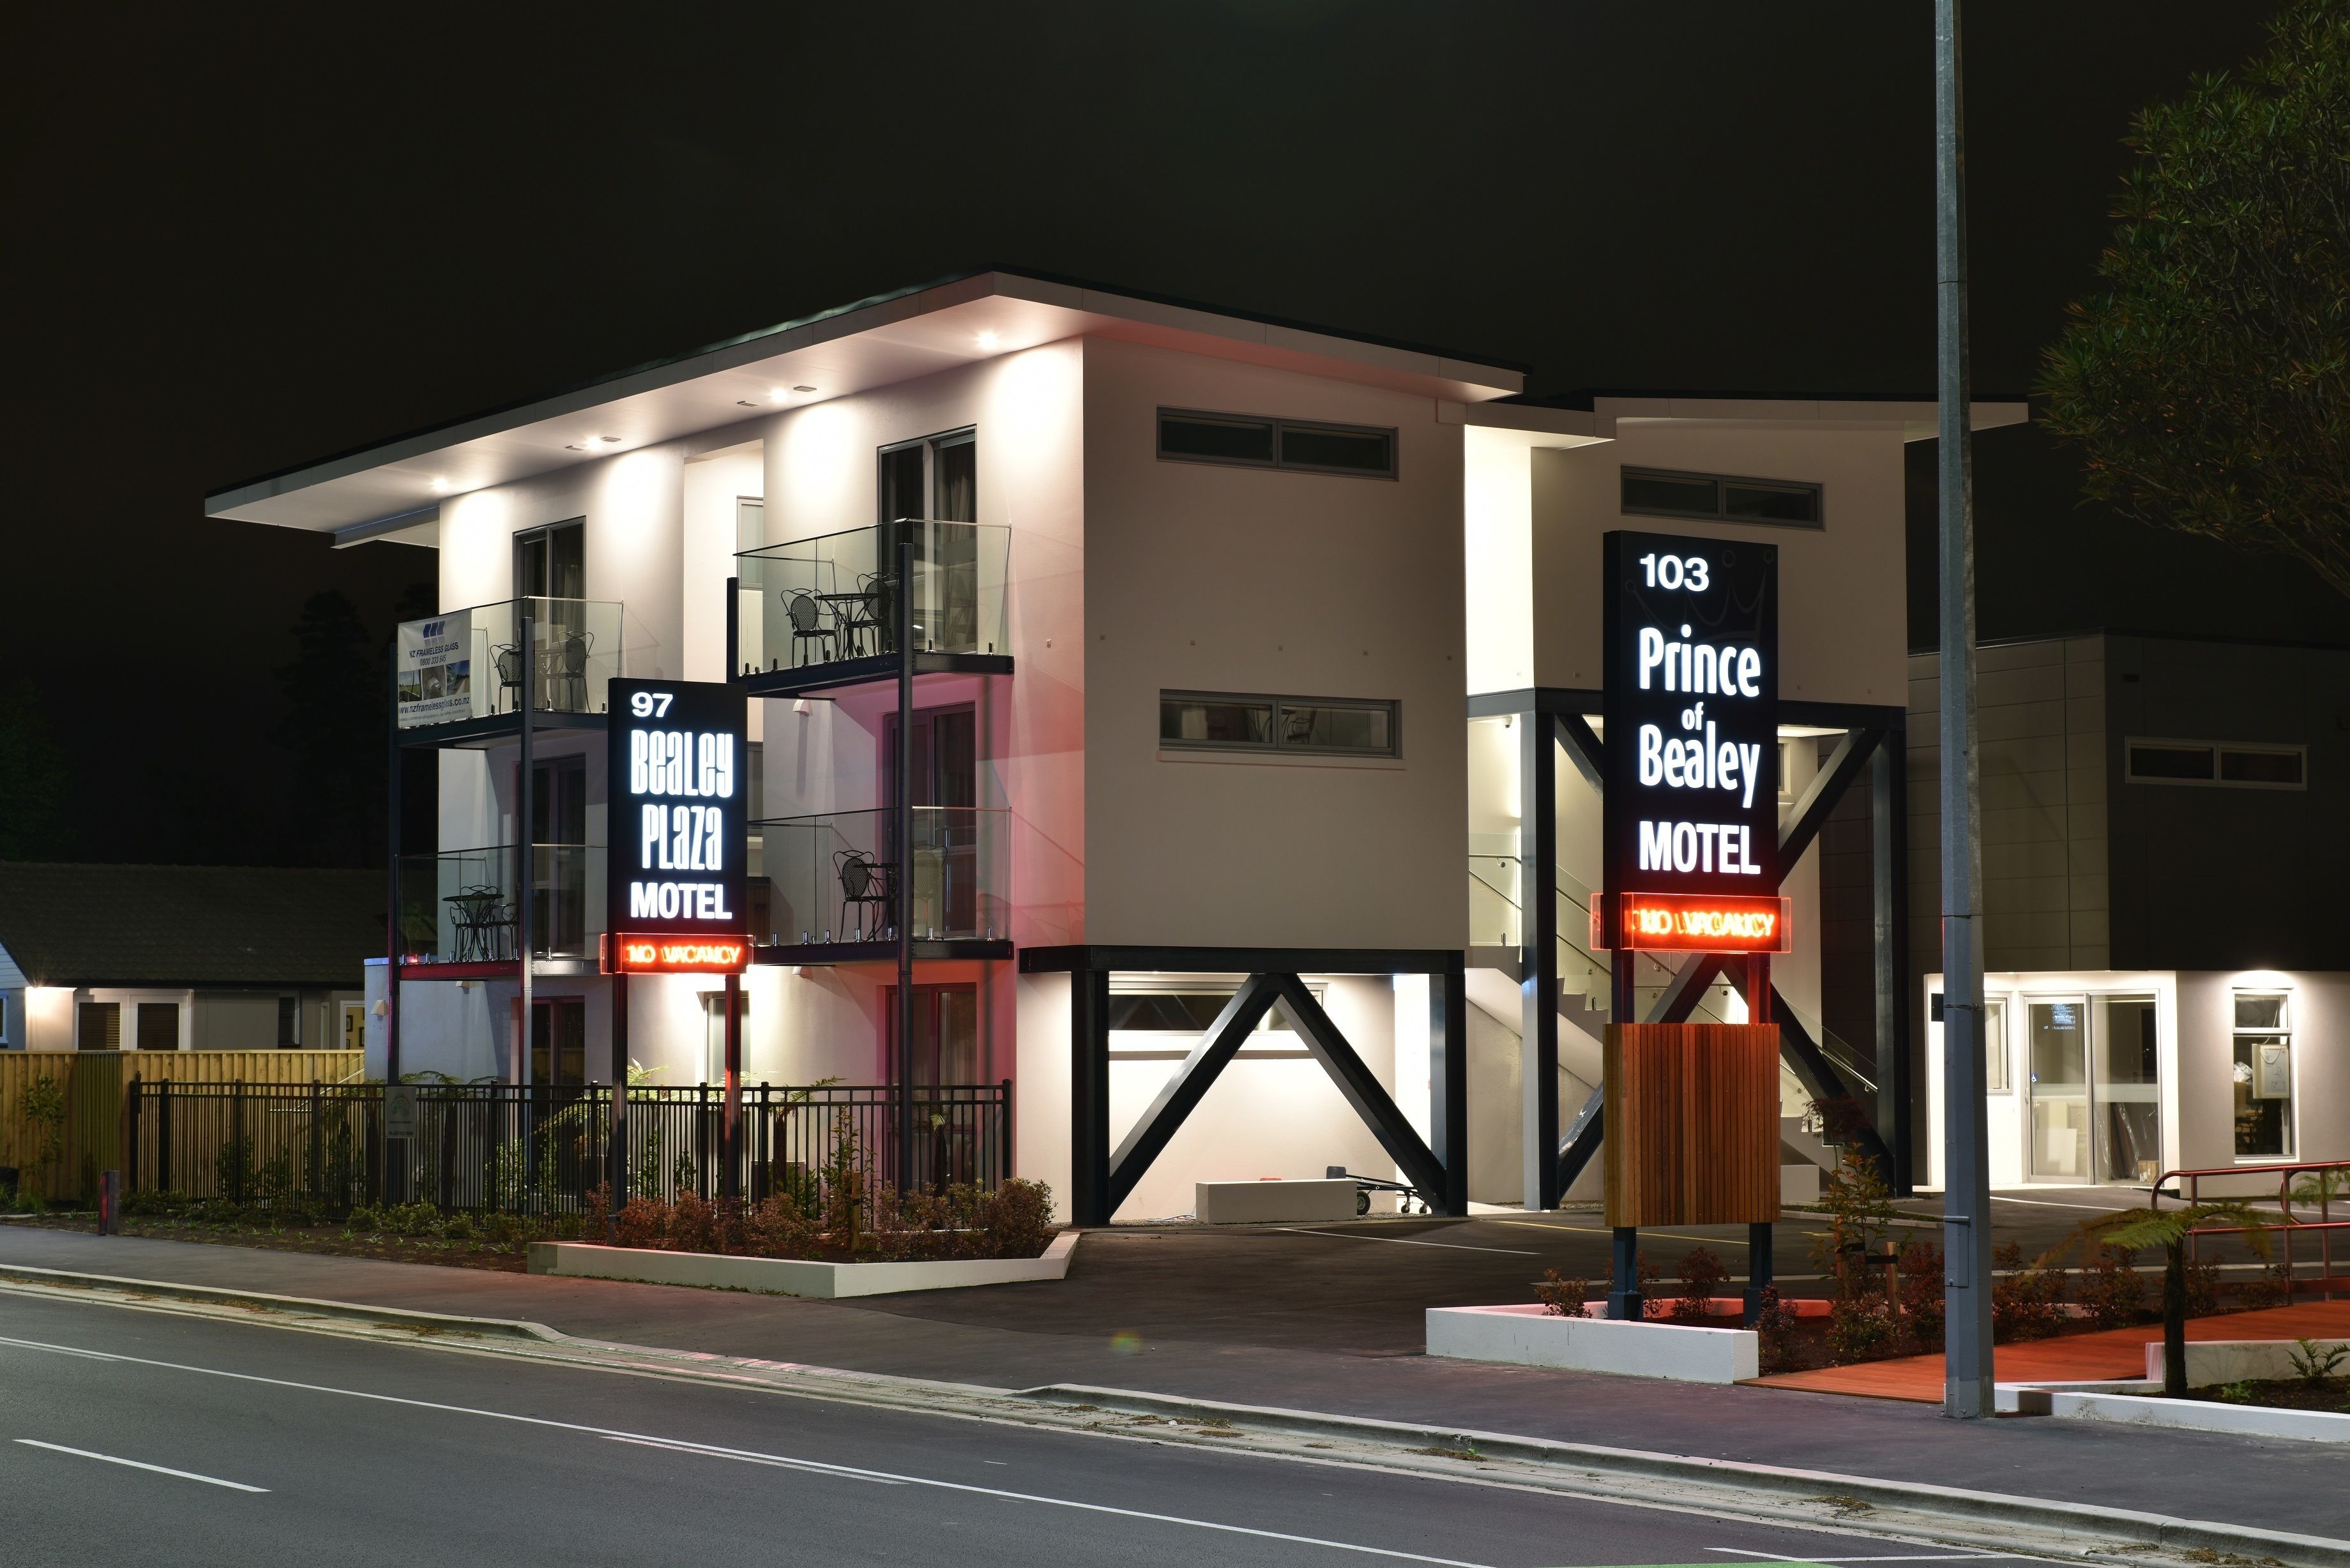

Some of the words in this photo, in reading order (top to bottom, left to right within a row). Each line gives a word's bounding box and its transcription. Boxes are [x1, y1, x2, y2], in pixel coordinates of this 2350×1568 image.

[1639, 553, 1709, 592] 103
[409, 650, 416, 658] NZ
[416, 645, 444, 658] FRAMELESS
[444, 642, 459, 652] GLASS
[420, 658, 431, 667] 0800
[439, 654, 447, 663] 545
[1639, 624, 1761, 698] Prince
[631, 691, 673, 718] 97
[1681, 701, 1704, 731] of
[1639, 720, 1761, 809] Bealey
[1639, 820, 1761, 875] MOTEL
[630, 882, 733, 920] MOTEL
[1637, 908, 1673, 935] NO
[1677, 910, 1775, 939] VACANCY
[626, 944, 656, 964] NO
[660, 945, 741, 965] VACANCY
